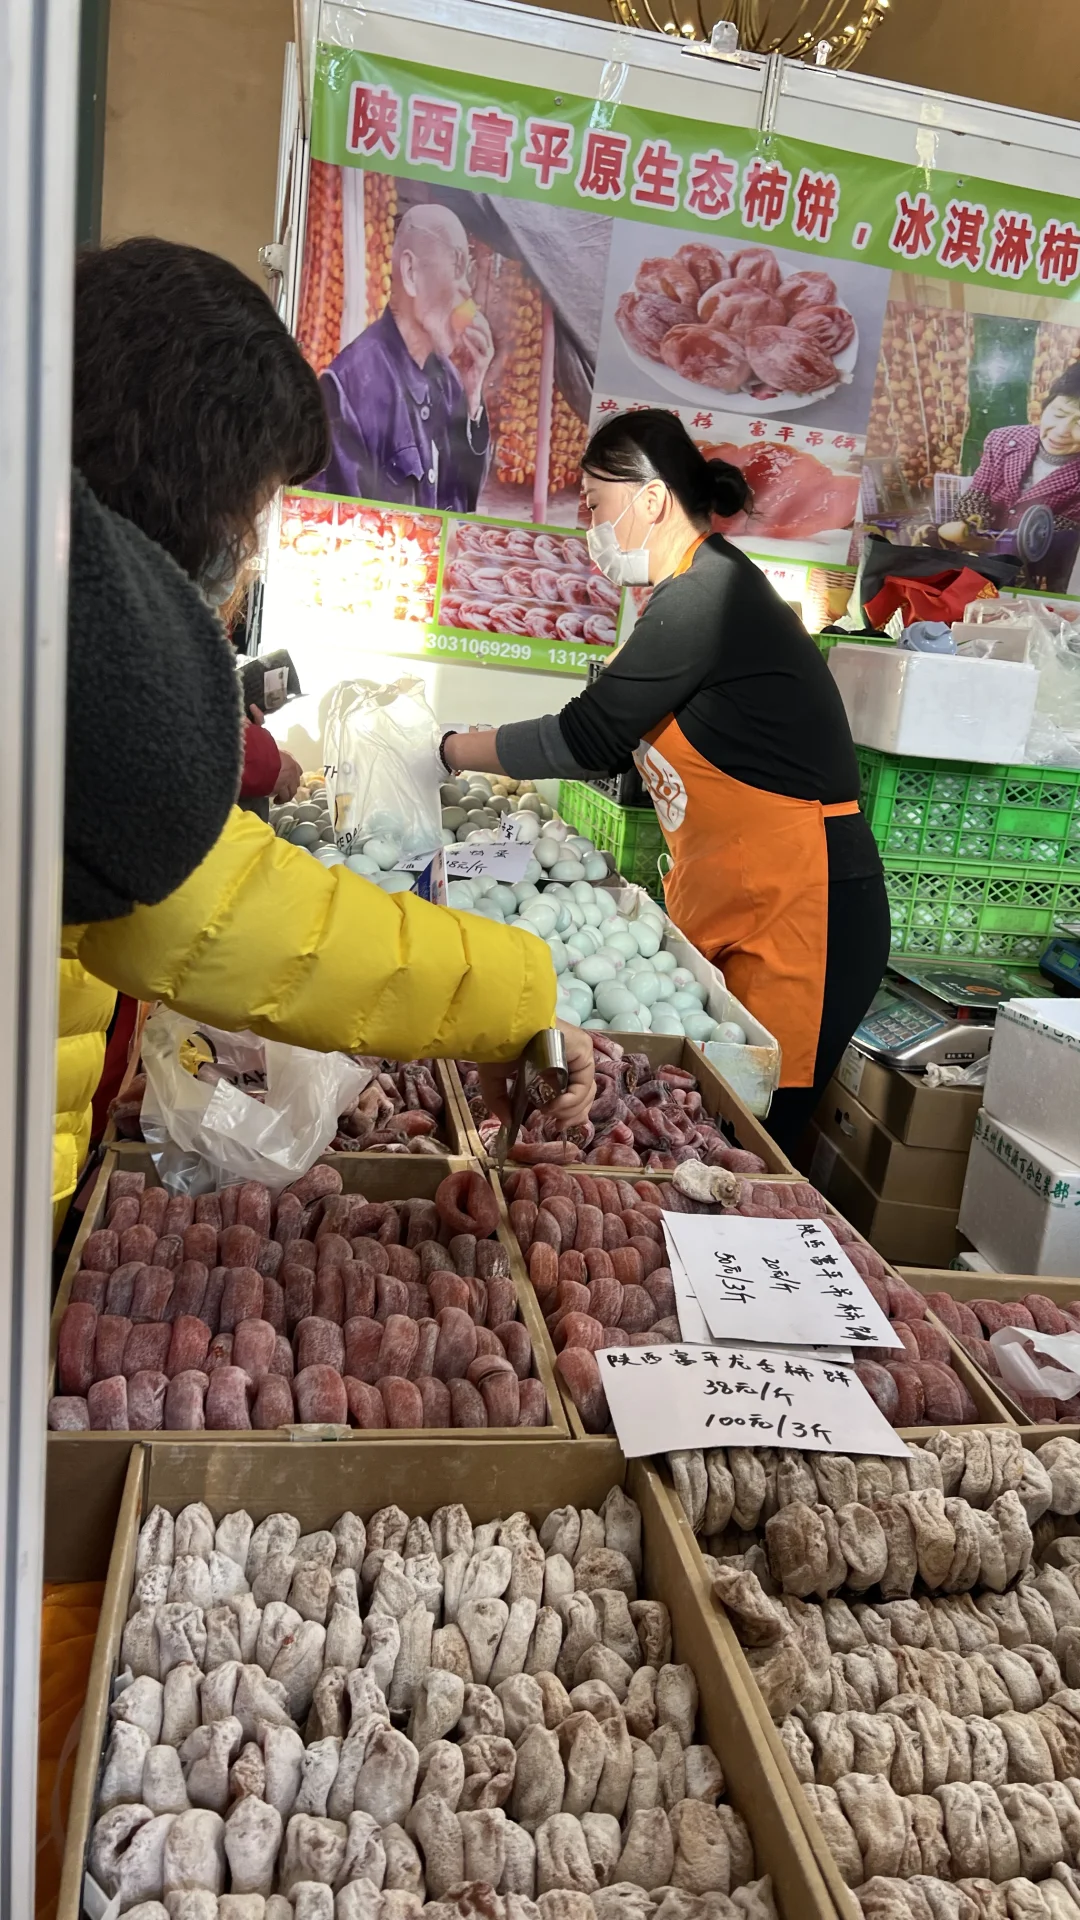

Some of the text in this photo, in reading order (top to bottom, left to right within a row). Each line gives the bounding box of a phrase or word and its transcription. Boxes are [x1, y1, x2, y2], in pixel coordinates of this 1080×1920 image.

[427, 633, 531, 660] 3031069299
[703, 1379, 795, 1407] 38元/斤
[705, 1414, 832, 1445] 100元/3斤
